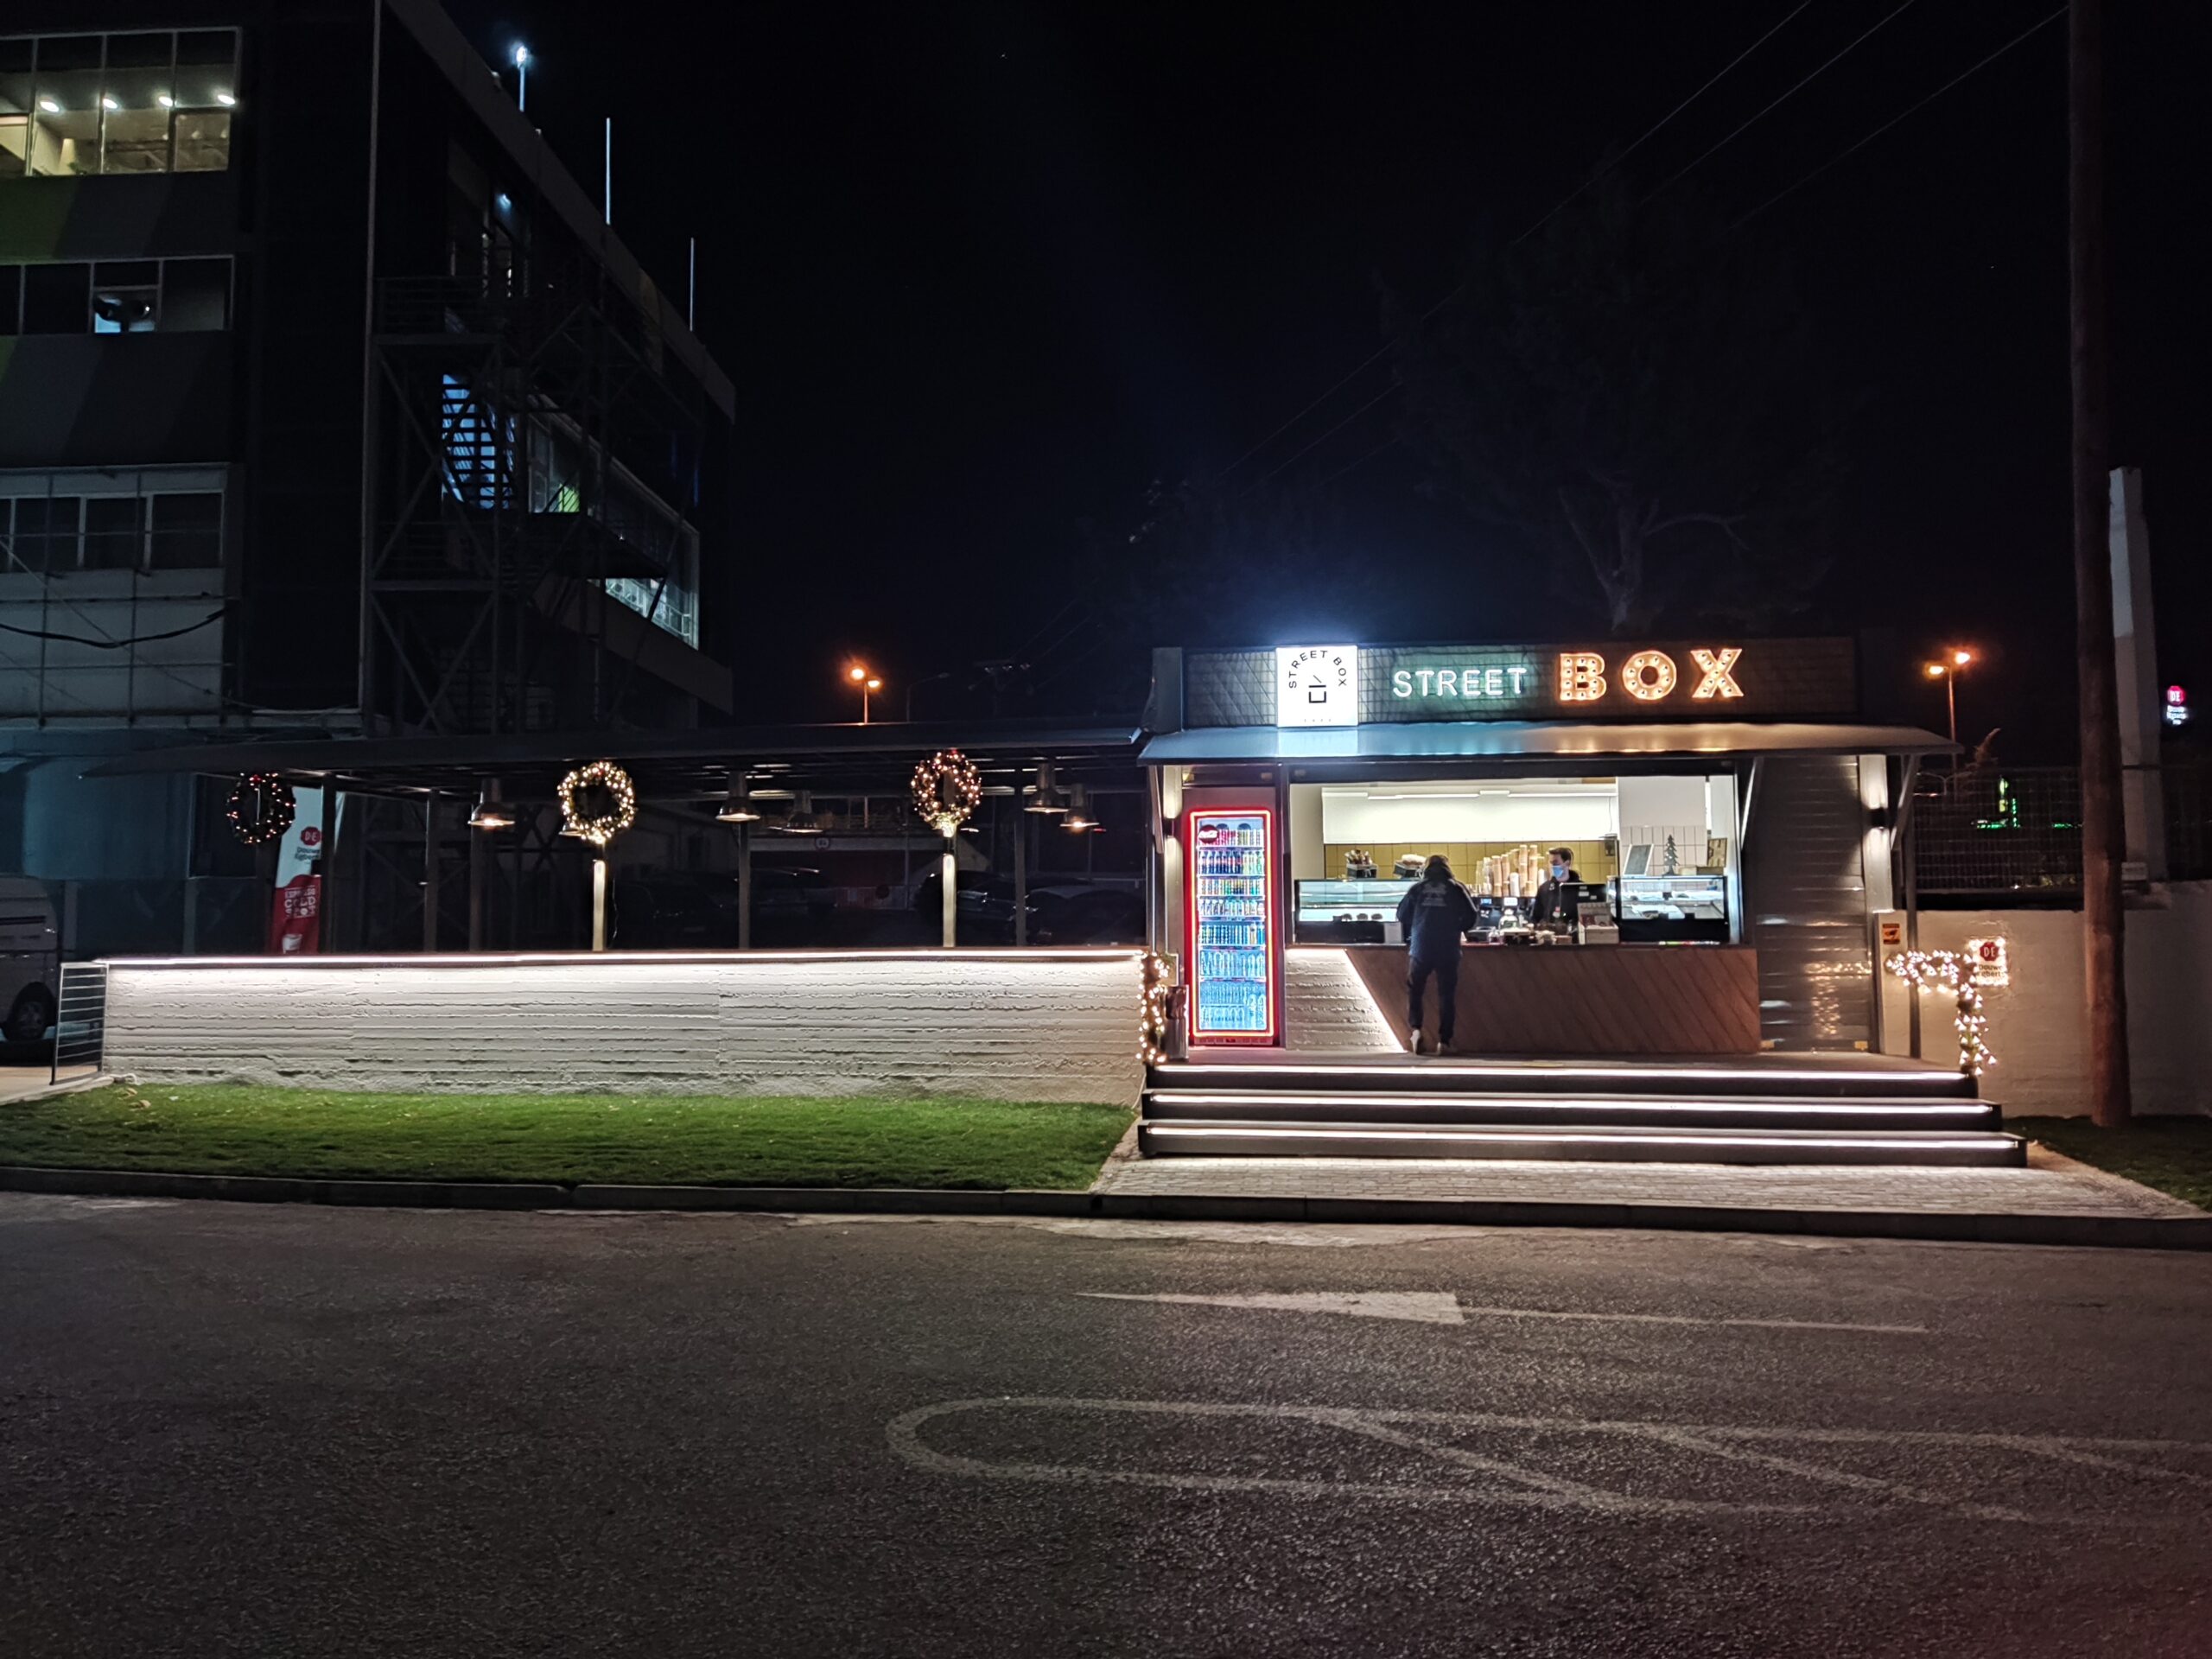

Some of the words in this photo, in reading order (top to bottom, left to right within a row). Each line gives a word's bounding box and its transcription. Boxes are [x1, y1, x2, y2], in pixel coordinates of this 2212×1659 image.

[1288, 650, 1328, 689] STREET
[1333, 657, 1347, 687] BOX
[1392, 666, 1528, 698] STREET
[1558, 648, 1745, 702] BOX
[304, 830, 318, 842] DE
[1983, 946, 1996, 957] DE
